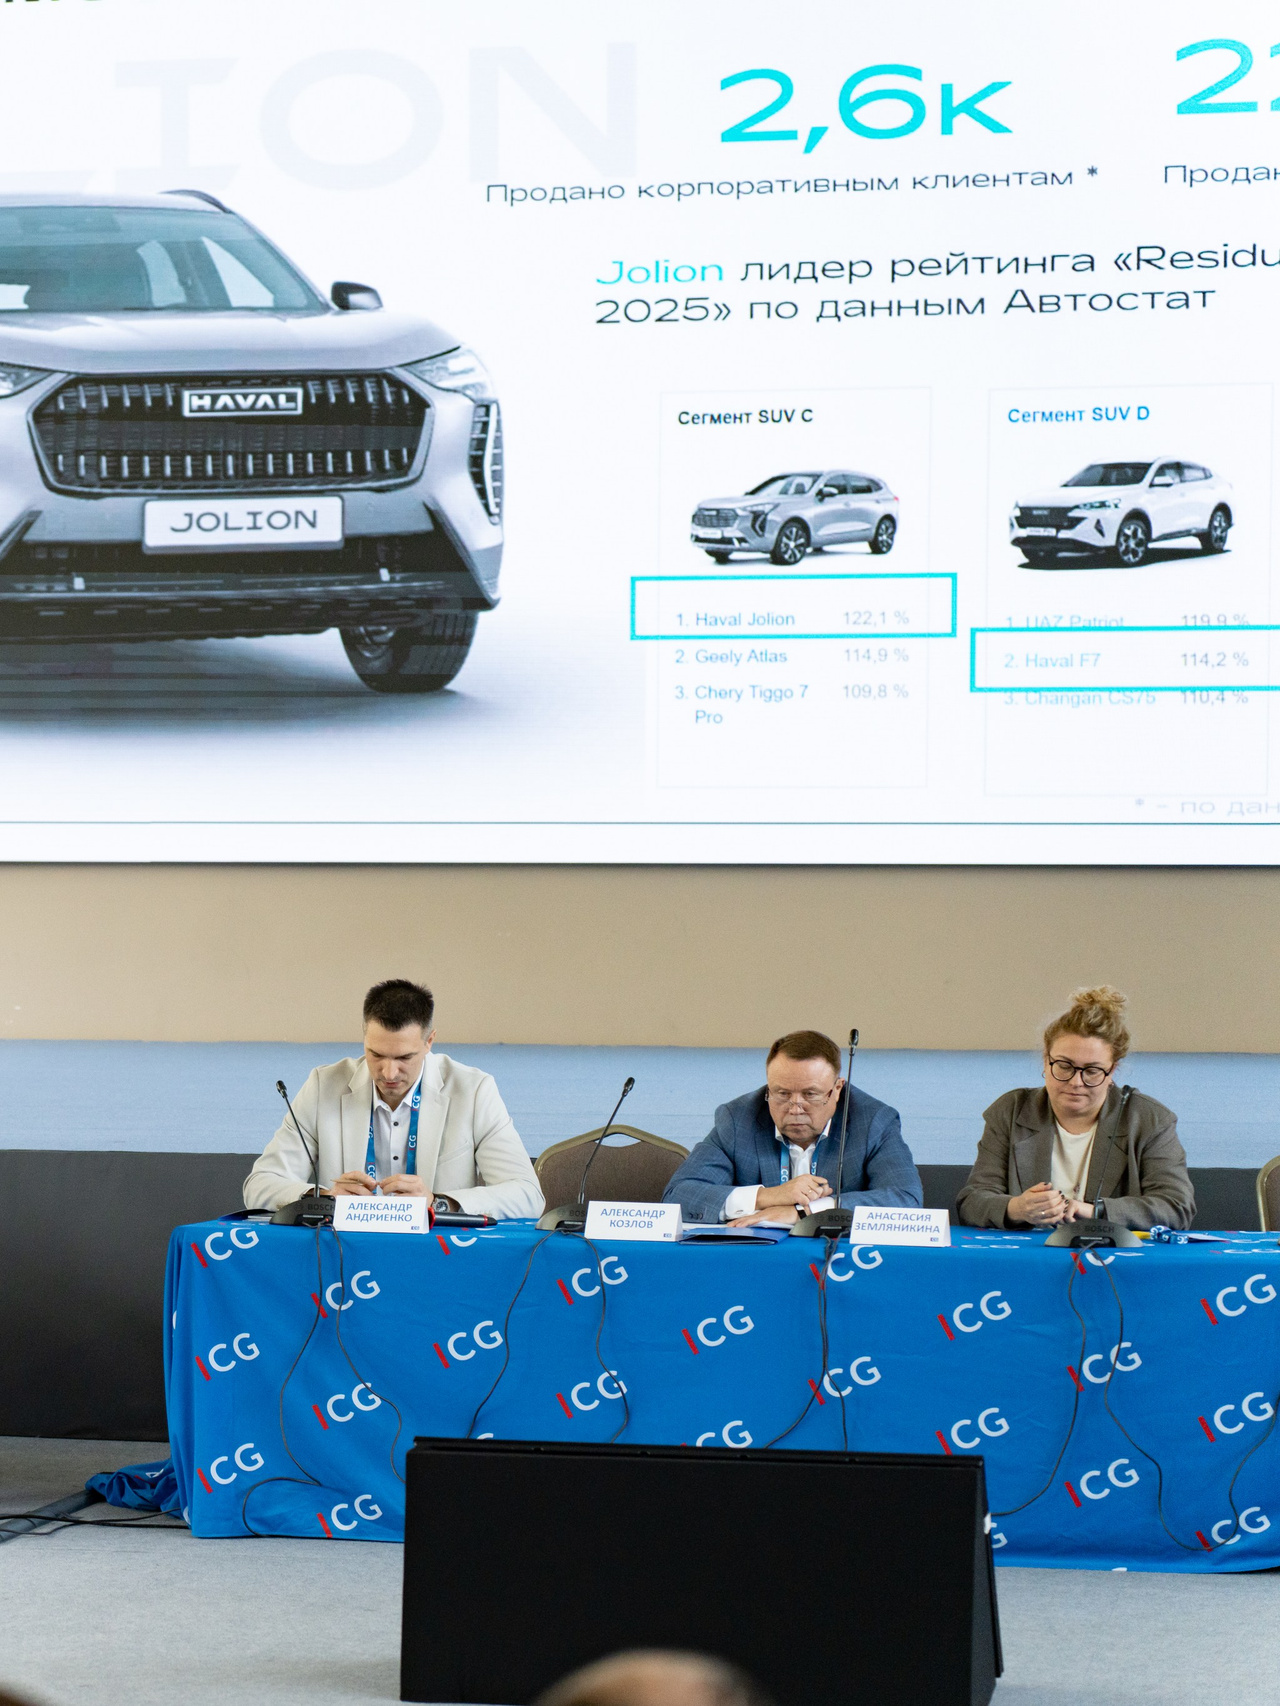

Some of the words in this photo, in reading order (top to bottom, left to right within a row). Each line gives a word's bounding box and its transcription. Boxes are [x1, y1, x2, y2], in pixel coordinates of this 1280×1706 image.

[1176, 38, 1280, 115] 2
[487, 185, 625, 206] Продано
[639, 178, 898, 201] корпоративным
[913, 172, 1072, 189] клиентам
[596, 260, 723, 284] Jolion
[741, 260, 872, 284] лидер
[891, 252, 1095, 281] рейтинга
[596, 297, 731, 324] 2025»
[750, 301, 798, 319] по
[816, 298, 984, 322] данным
[1003, 289, 1216, 314] Автостат
[190, 394, 296, 410] HAVAL
[678, 411, 752, 425] Сегмент
[758, 409, 795, 423] SUV
[1008, 409, 1085, 423] Сегмент
[1092, 406, 1130, 421] SUV
[1137, 406, 1150, 420] D
[170, 510, 317, 532] JOLION
[676, 612, 690, 627] 1.
[695, 612, 742, 627] Haval
[748, 612, 795, 627] Jolion
[844, 610, 886, 627] 122,1
[894, 610, 910, 625] %
[1181, 614, 1228, 627] 1199
[675, 649, 689, 664] 2.
[695, 649, 742, 666] Geely
[747, 649, 788, 663] Atlas
[844, 648, 888, 664] 114,9
[894, 648, 909, 662] %
[1003, 654, 1019, 669] 2.
[1025, 653, 1074, 668] Haval
[1079, 653, 1101, 668] F7
[1181, 652, 1227, 669] 114,2
[1233, 652, 1250, 667] %
[674, 685, 689, 699] 3.
[695, 685, 744, 703] Chery
[749, 685, 794, 703] Tiggo
[799, 684, 809, 699] 7
[843, 684, 887, 701] 109,8
[893, 684, 909, 698] %
[1025, 691, 1103, 708] Changan
[1108, 691, 1156, 705] CS75
[1180, 690, 1226, 706] 110,4
[1233, 690, 1249, 704] %
[695, 710, 723, 724] Pro
[1180, 802, 1216, 814] по
[346, 1213, 412, 1222] АНДРИЕНКО
[348, 1203, 412, 1212] АЛЕКСАНДР
[569, 1210, 587, 1218] BOS
[601, 1209, 665, 1219] АЛЕКСАНДР
[610, 1220, 653, 1228] КОЗЛОВ
[828, 1214, 852, 1222] BOSC
[867, 1212, 931, 1221] АНАСТАСИЯ
[855, 1222, 940, 1233] ЗЕМЛЯНИКИНА
[1084, 1225, 1115, 1233] BOSCH
[191, 1228, 259, 1268] ICG
[557, 1256, 628, 1305] ICG
[809, 1244, 884, 1289] ICG
[311, 1271, 380, 1318] ICG
[1201, 1274, 1276, 1325] ICG
[682, 1306, 754, 1354] ICG
[938, 1291, 1011, 1340] ICG
[195, 1333, 259, 1381] ICG
[433, 1321, 503, 1368] ICG
[808, 1357, 881, 1405] ICG
[1067, 1342, 1142, 1391] ICG
[312, 1383, 381, 1430] ICG
[556, 1371, 627, 1418] ICG
[936, 1408, 1009, 1455] ICG
[1198, 1392, 1274, 1442] ICG
[197, 1443, 264, 1493] ICG
[1065, 1459, 1139, 1507] ICG
[317, 1495, 382, 1537] ICG
[1196, 1507, 1270, 1546] ICG
